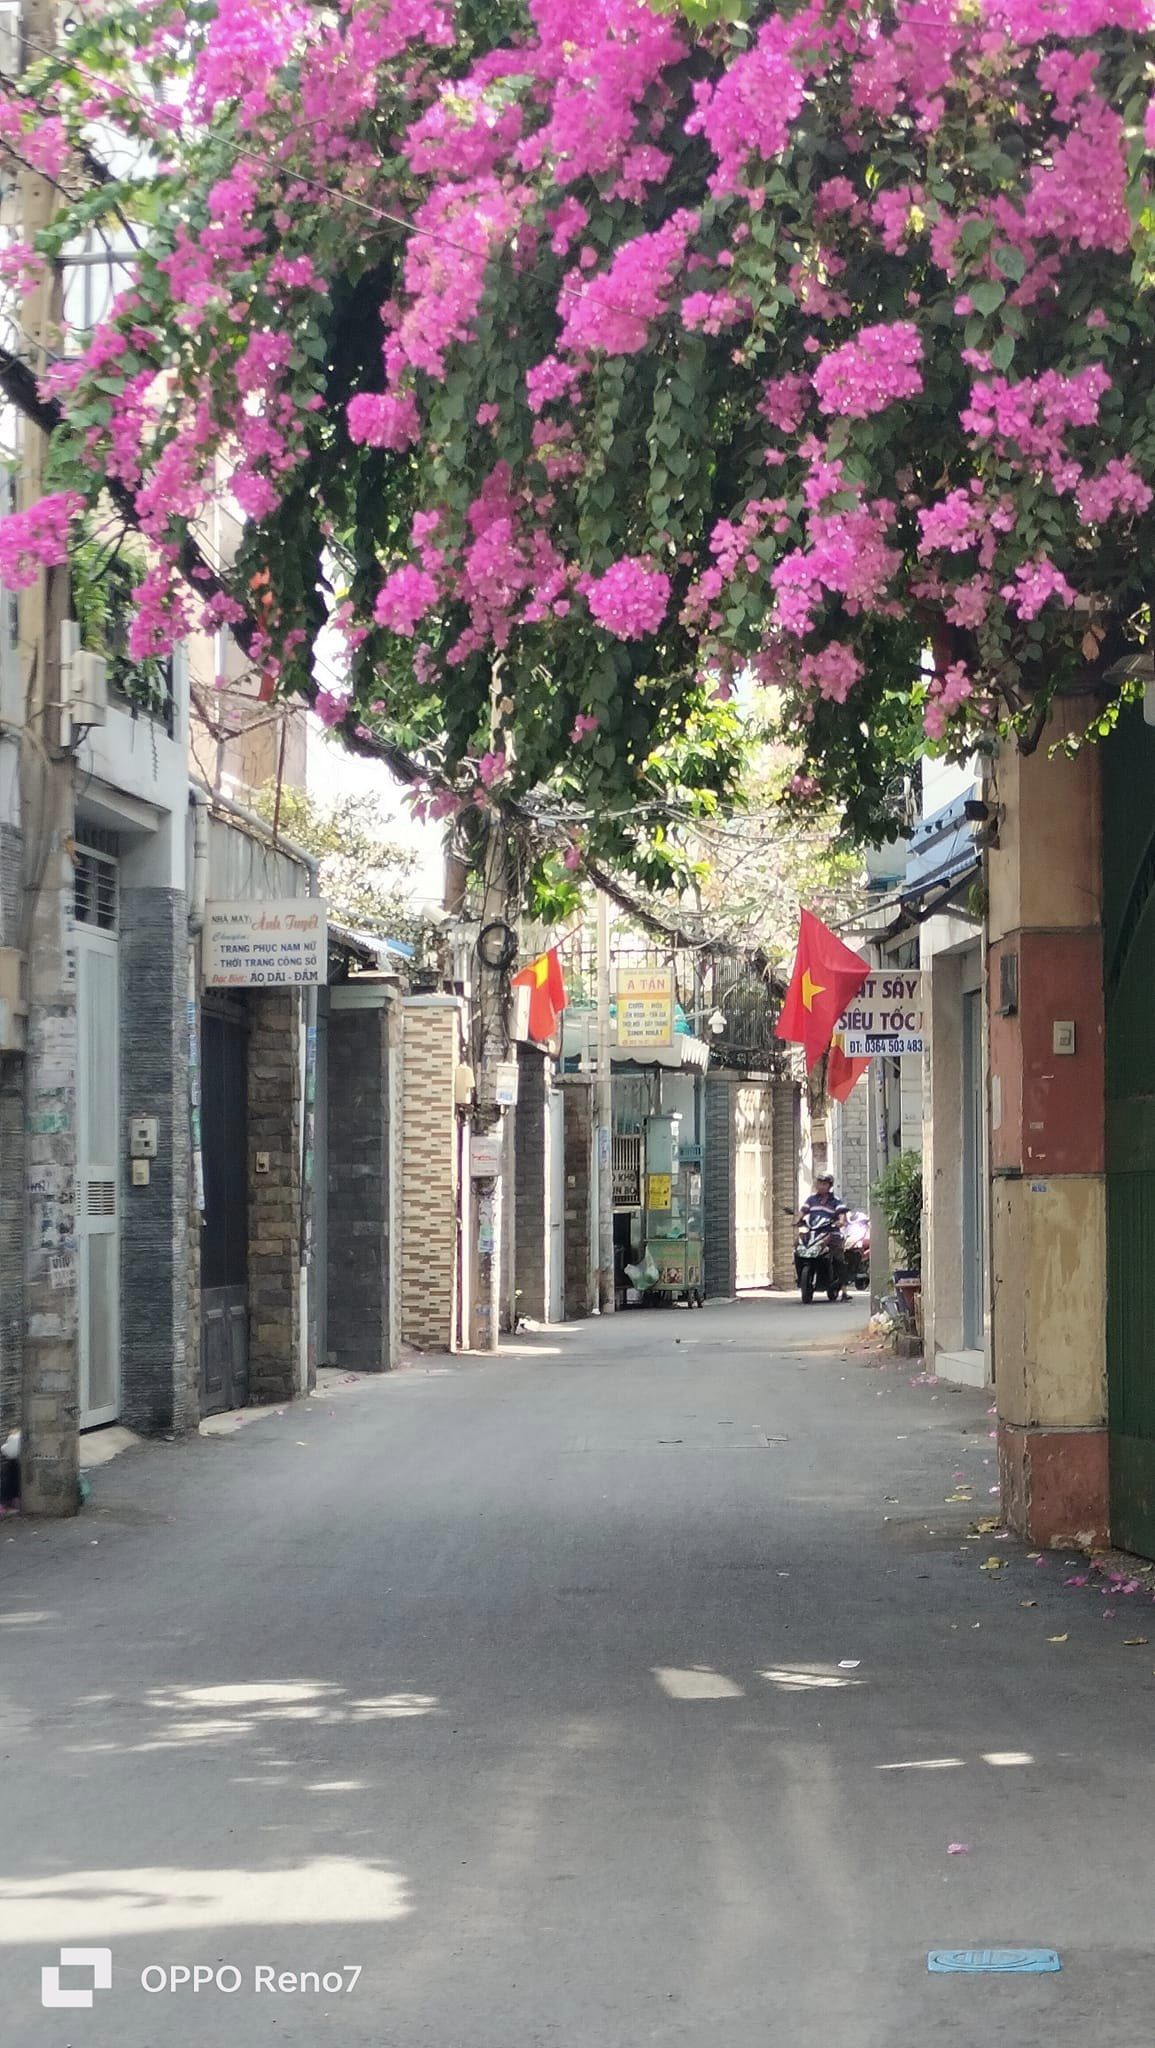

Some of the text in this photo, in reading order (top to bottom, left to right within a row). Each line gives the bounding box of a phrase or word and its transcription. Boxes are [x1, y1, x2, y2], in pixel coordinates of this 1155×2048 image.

[220, 944, 250, 953] TRANG
[281, 943, 300, 952] NAM
[245, 958, 275, 967] TRANG
[278, 956, 302, 966] CÔNG
[882, 973, 918, 999] SẤY
[838, 1006, 915, 1031] SIÊU TỐC
[865, 1040, 886, 1053] 0364
[889, 1040, 905, 1052] 503
[907, 1040, 923, 1052] 483
